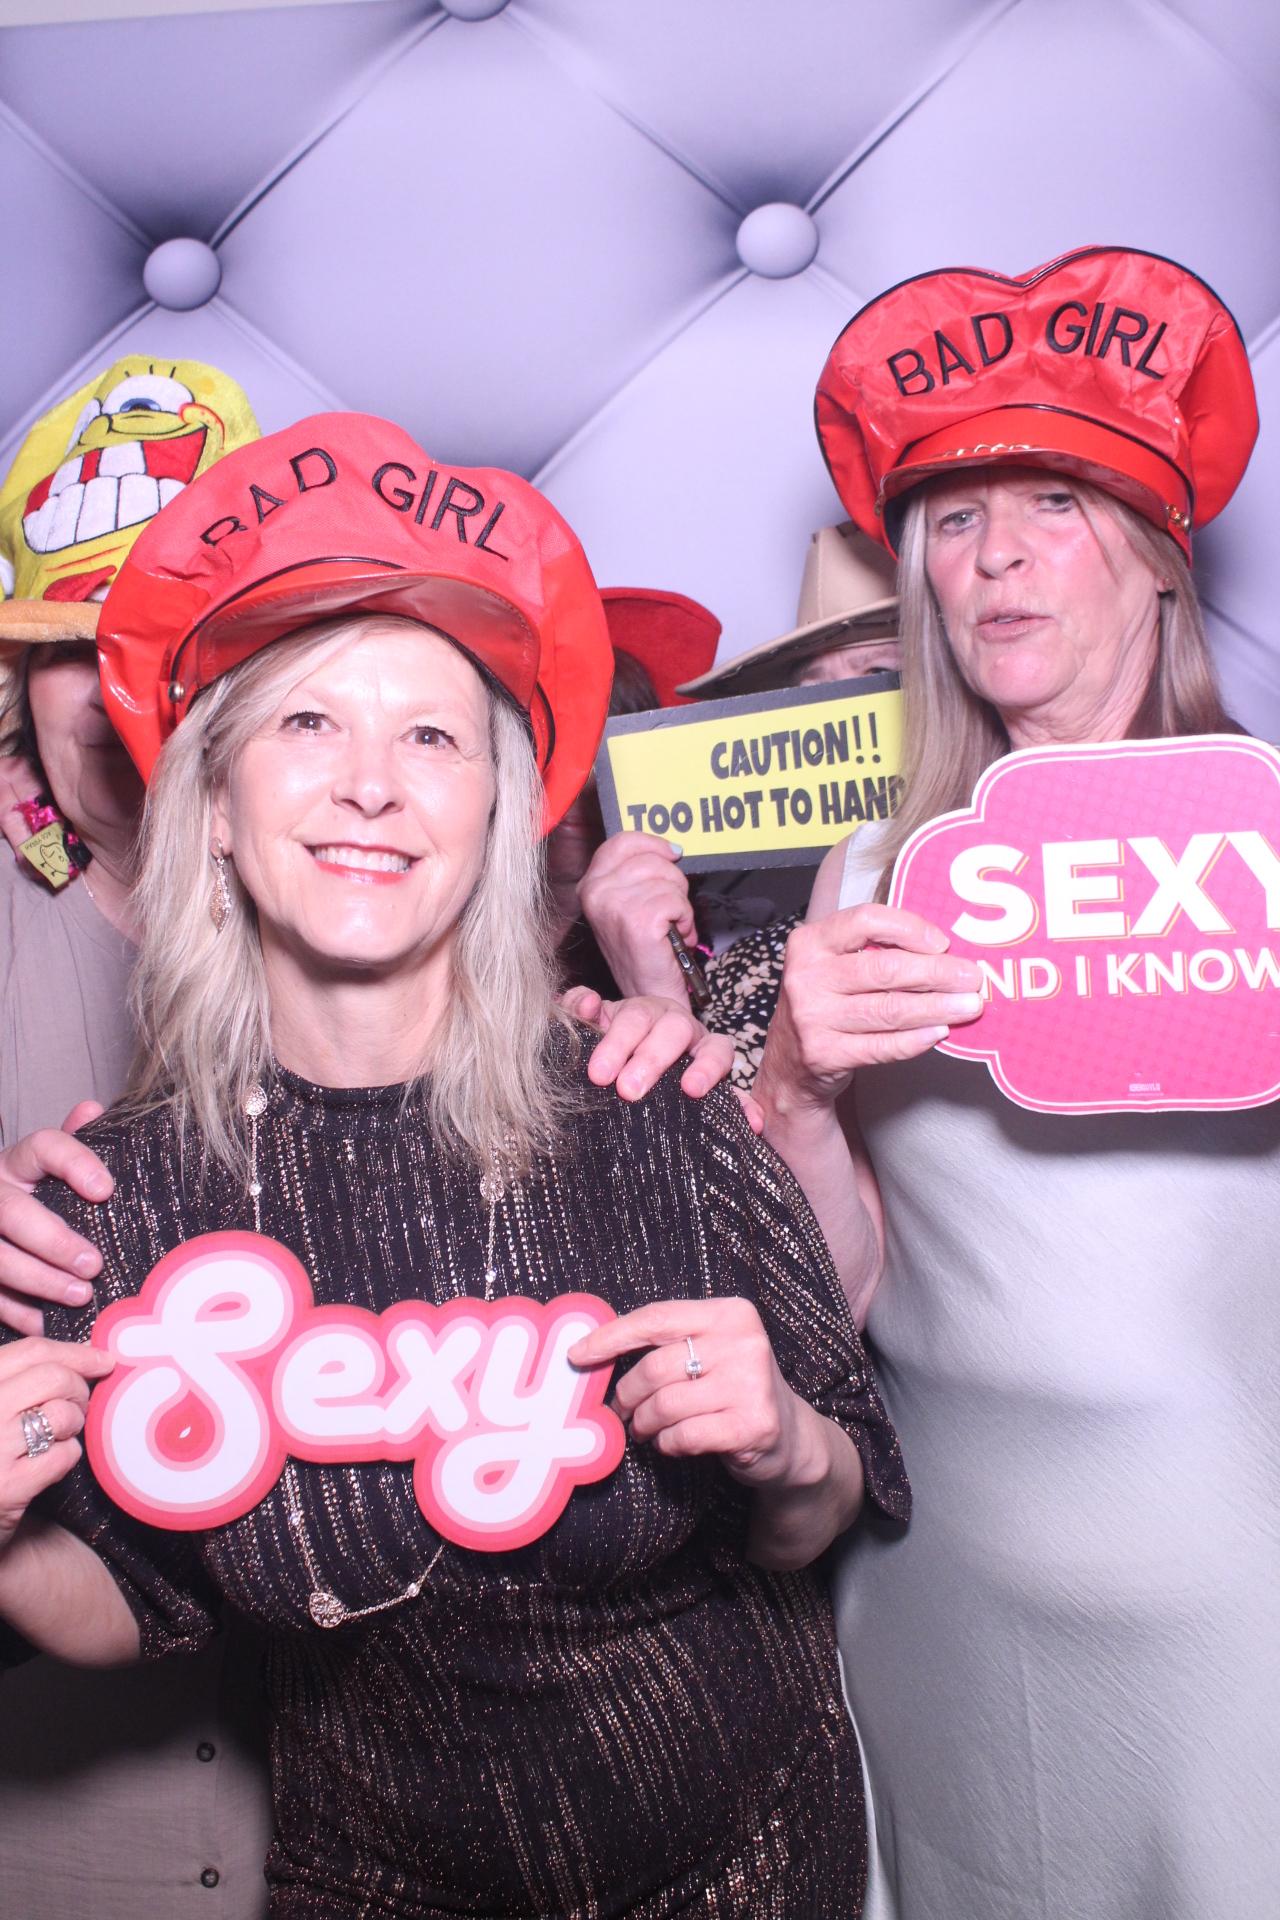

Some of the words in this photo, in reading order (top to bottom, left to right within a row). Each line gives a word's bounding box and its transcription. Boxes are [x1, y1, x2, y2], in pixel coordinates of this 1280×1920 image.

[887, 311, 1014, 396] BAD
[1046, 301, 1167, 380] GIRL
[372, 462, 509, 562] GIRL
[711, 712, 882, 780] CAUTION!!
[627, 801, 693, 834] TOO
[699, 790, 763, 833] HOT
[770, 787, 813, 828] TO
[819, 775, 905, 825] HAND
[949, 830, 1280, 948] SEXY
[976, 957, 1063, 1002] ND
[1075, 954, 1092, 998] I
[1106, 946, 1280, 997] KNOW
[110, 1259, 597, 1524] Sexy
